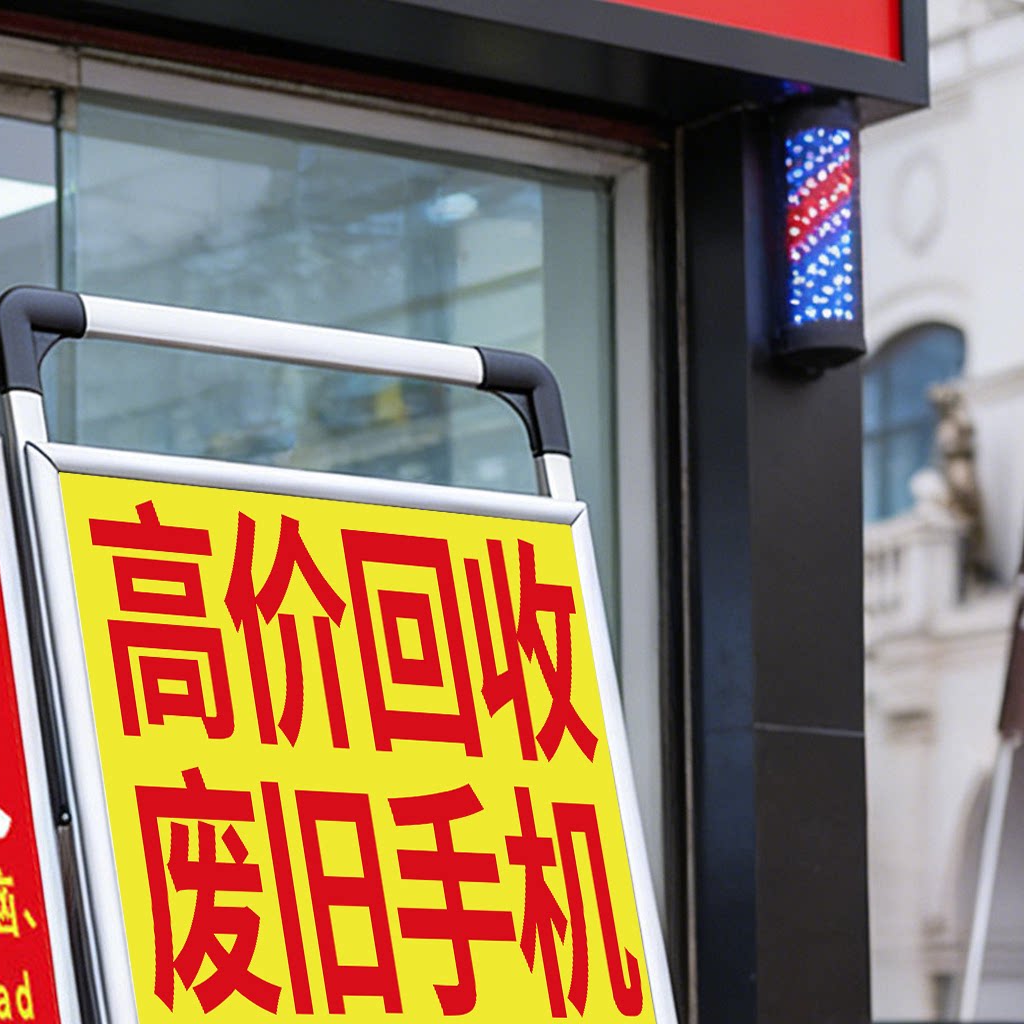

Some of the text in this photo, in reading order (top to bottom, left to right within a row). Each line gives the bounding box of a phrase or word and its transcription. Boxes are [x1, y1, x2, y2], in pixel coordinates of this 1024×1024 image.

[89, 500, 598, 763] 高价回收
[135, 767, 643, 1018] 废旧手机
